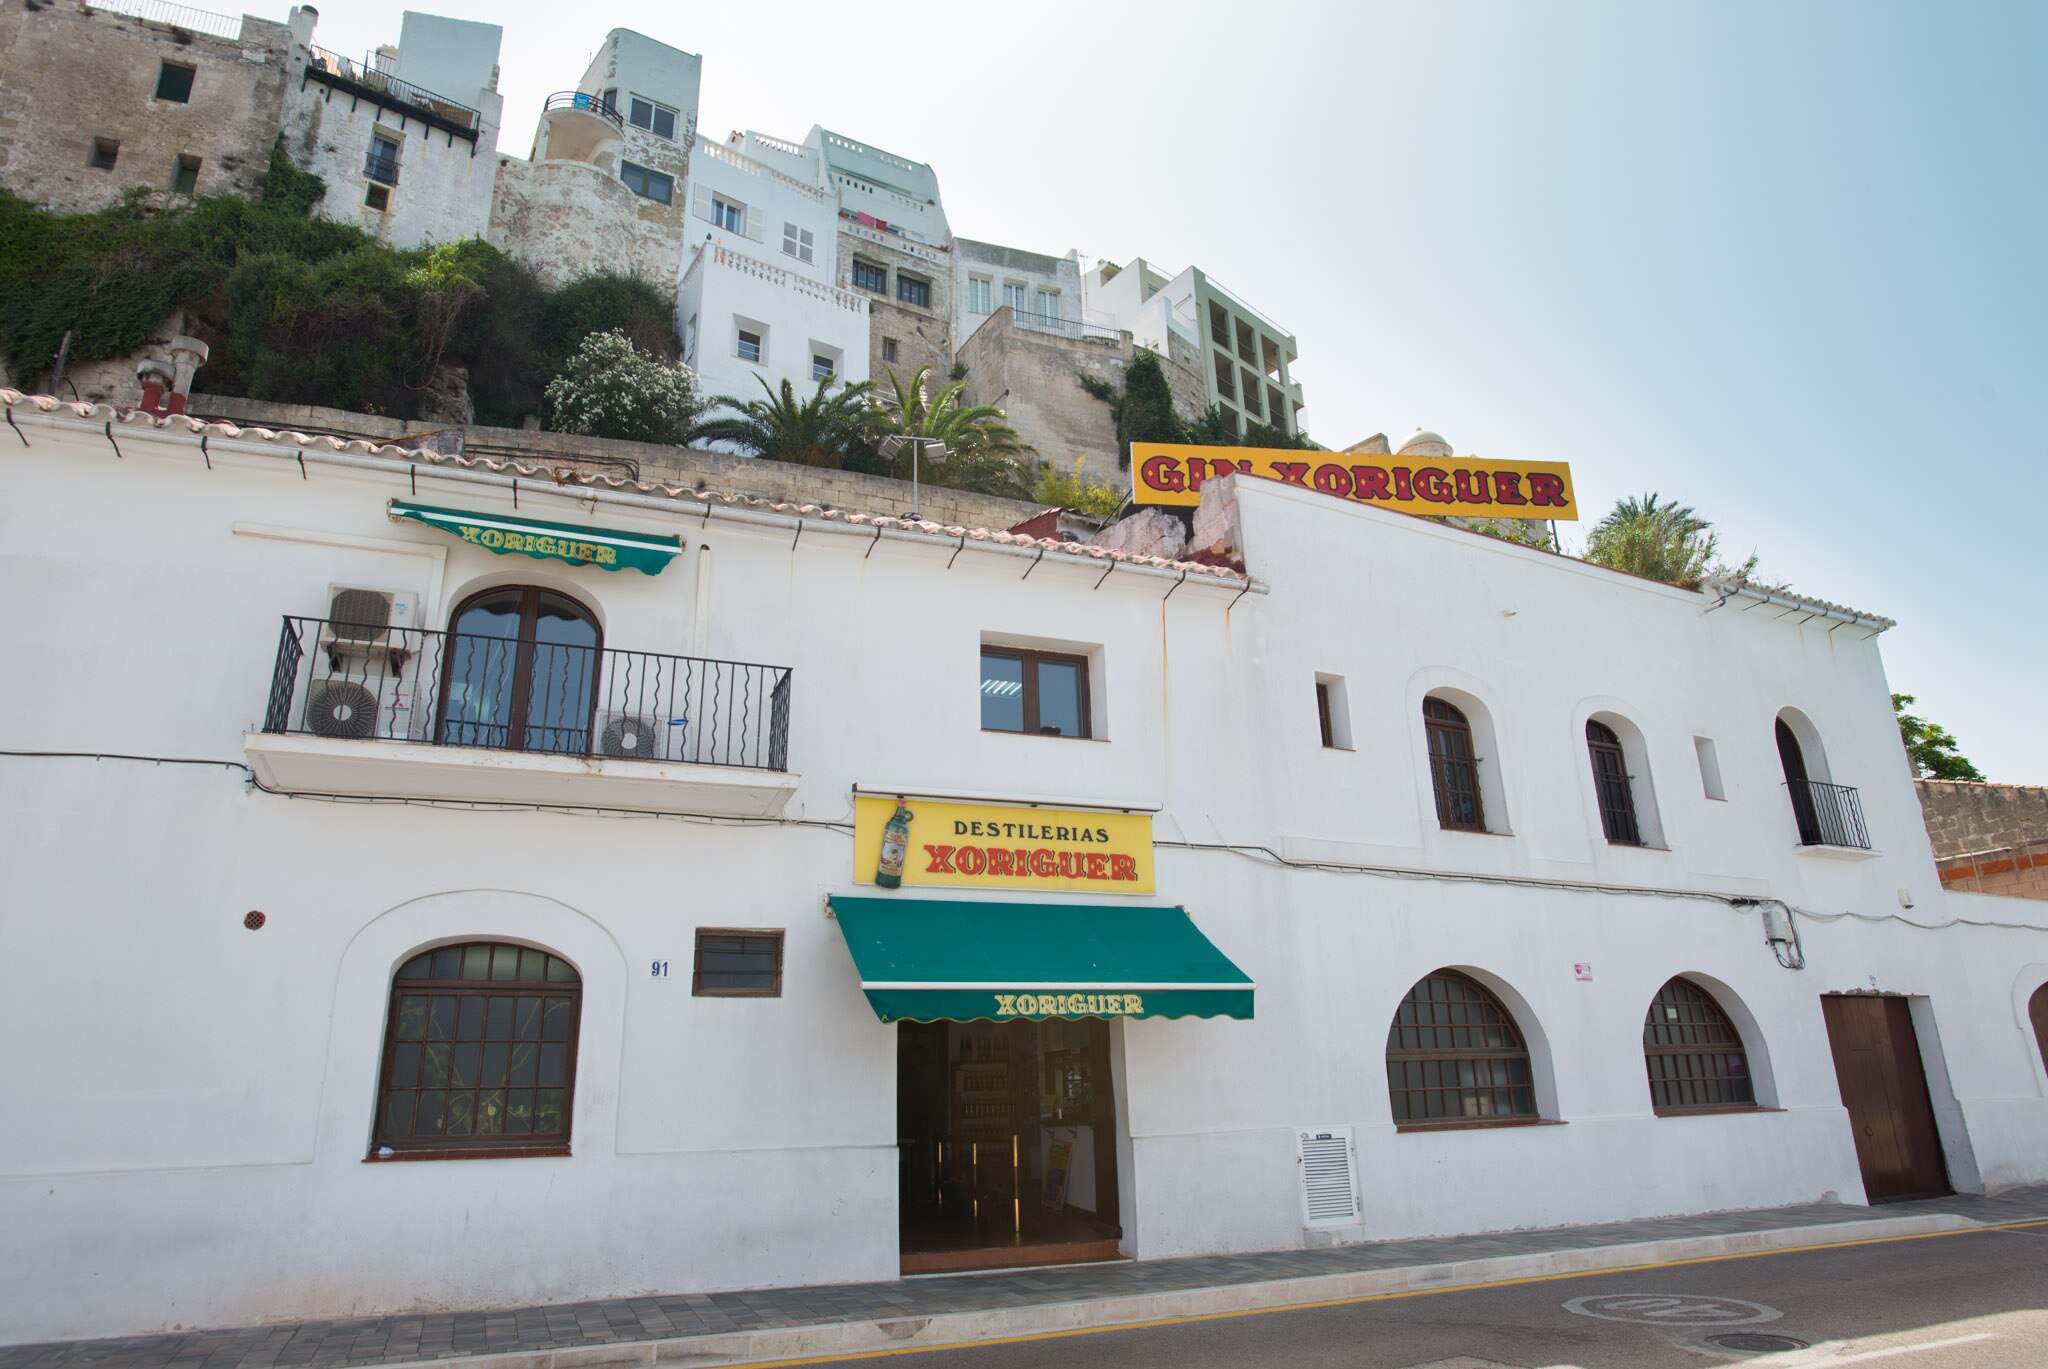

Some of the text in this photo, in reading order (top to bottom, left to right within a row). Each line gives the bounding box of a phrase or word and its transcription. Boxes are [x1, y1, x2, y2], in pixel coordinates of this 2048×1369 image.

[1270, 462, 1569, 506] XORIGUER
[459, 525, 617, 564] XORIGUER
[954, 820, 1109, 843] DESTILERIAS
[923, 845, 1138, 882] XORIGUER
[651, 961, 669, 977] 91
[994, 993, 1144, 1015] XORIGUER
